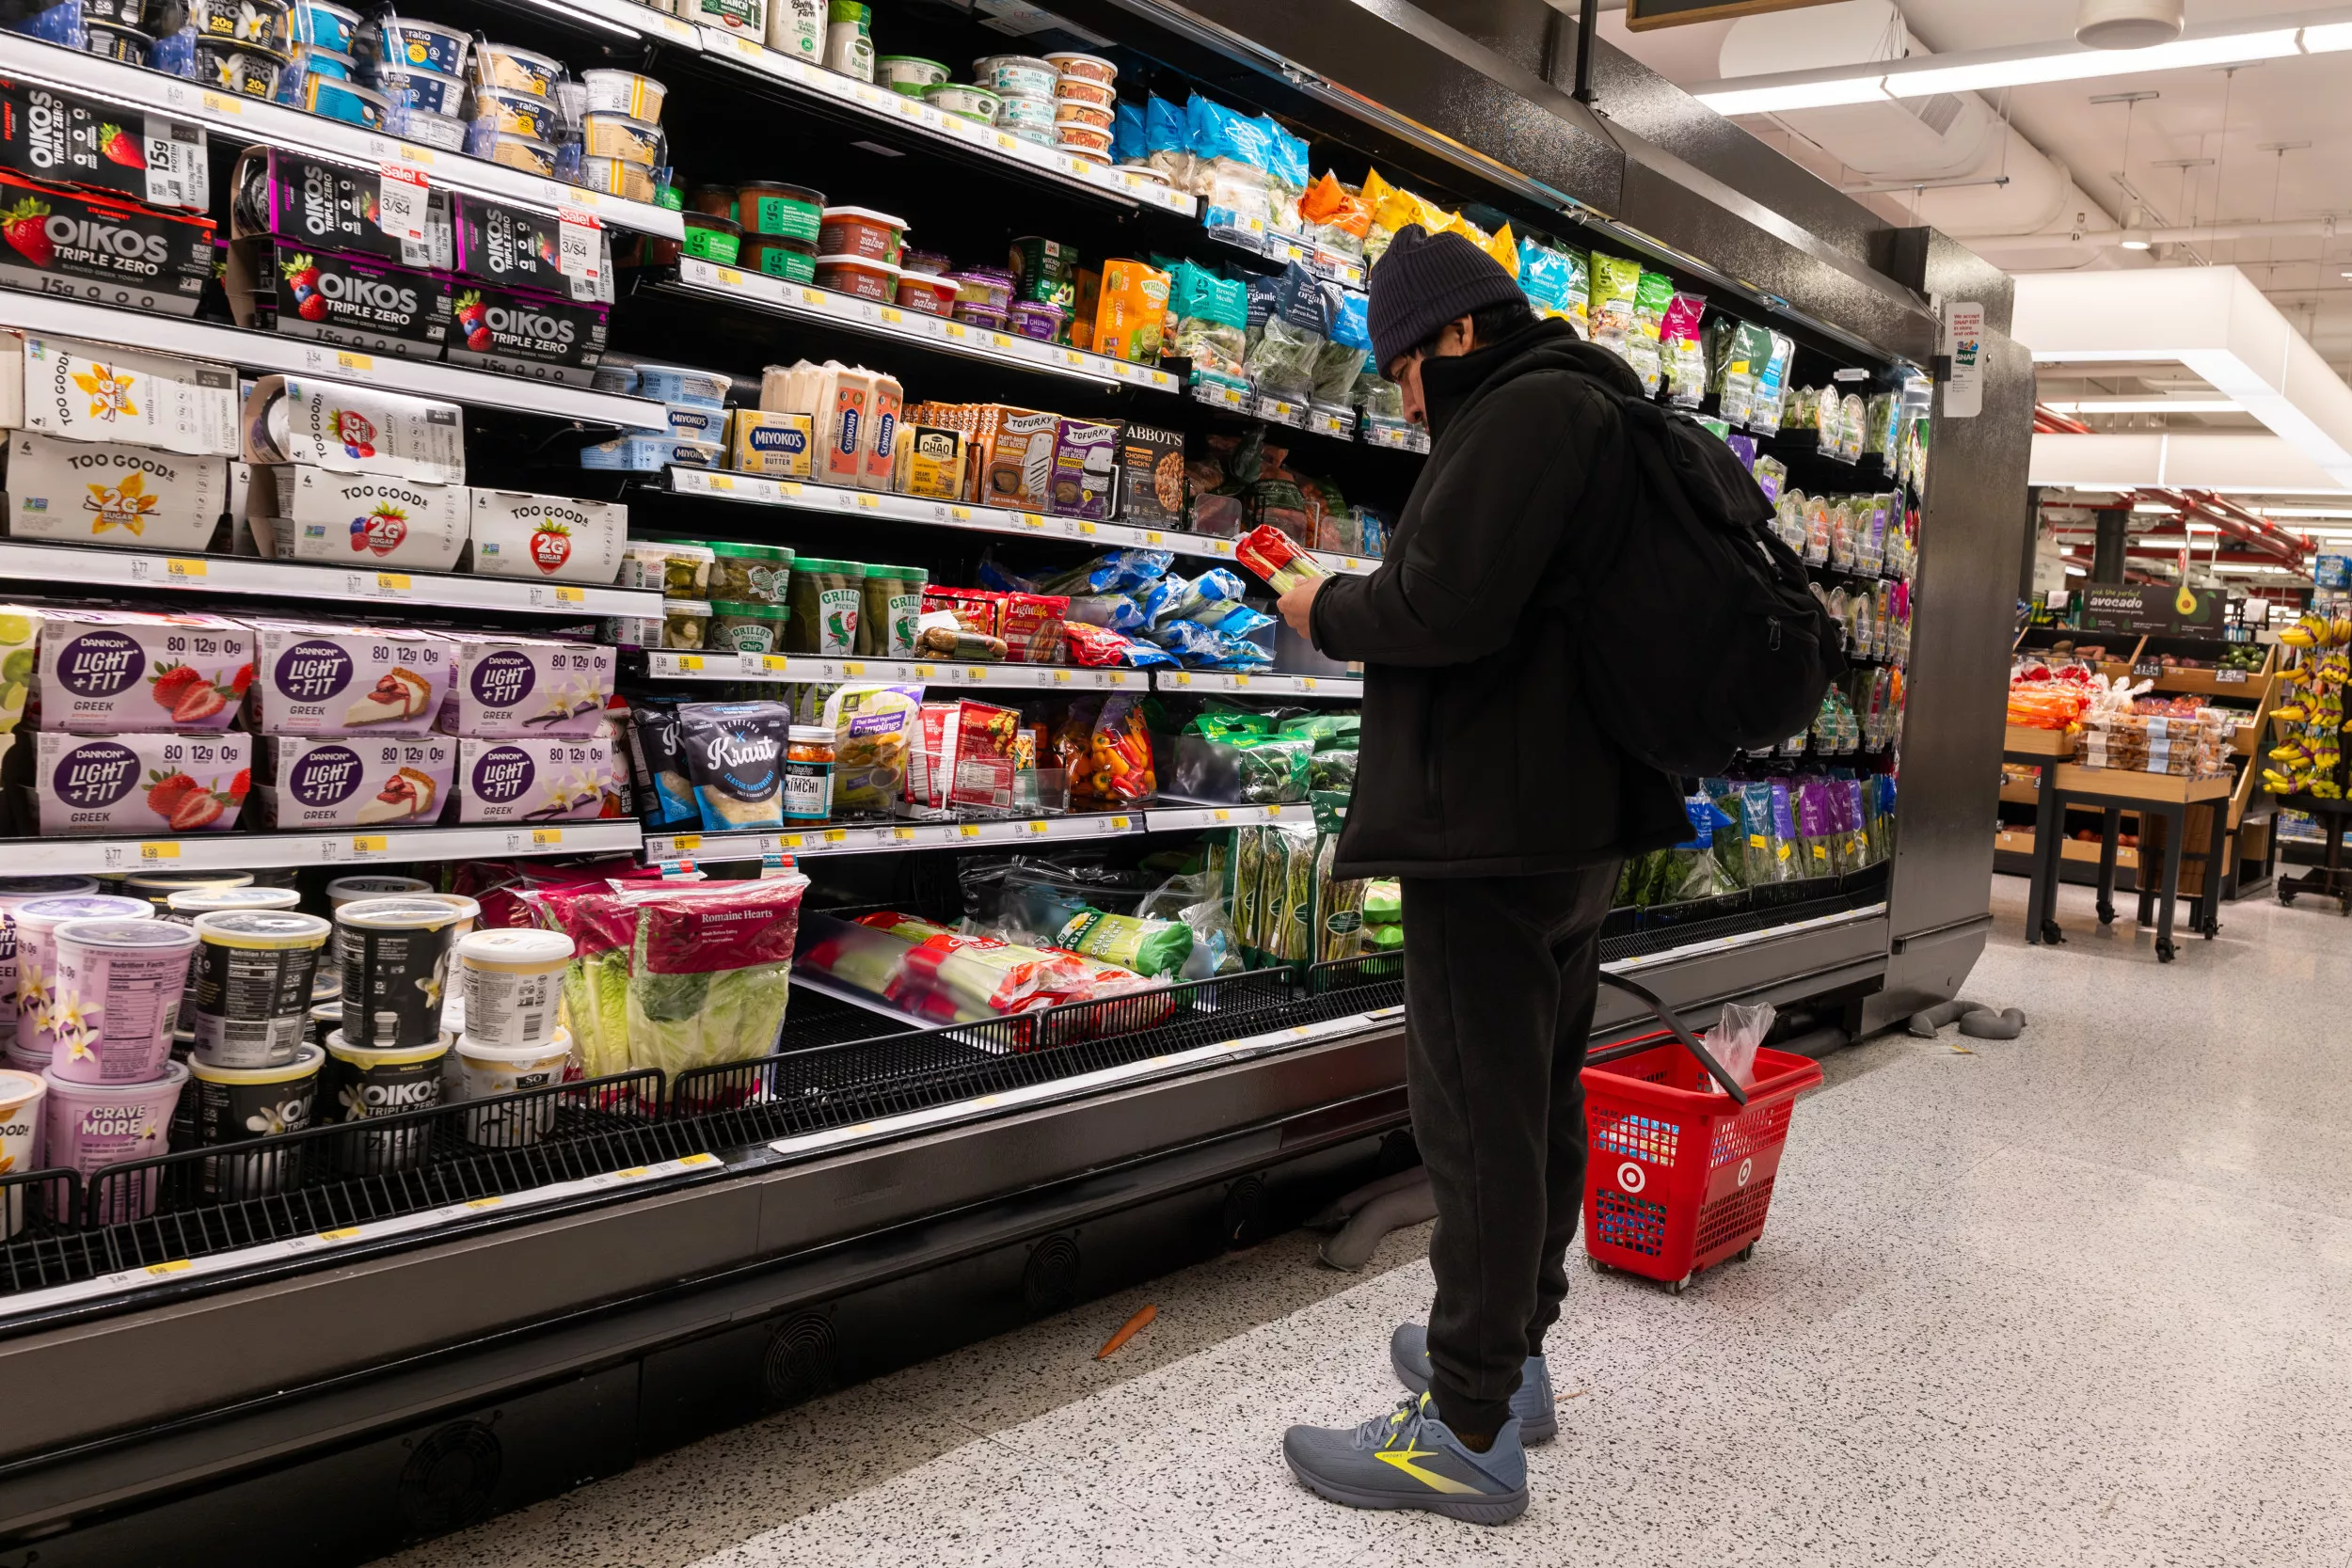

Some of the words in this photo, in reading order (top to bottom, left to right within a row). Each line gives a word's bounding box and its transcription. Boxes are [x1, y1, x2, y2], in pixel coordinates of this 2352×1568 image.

[207, 3, 239, 18] PRO
[210, 25, 232, 34] PROTEIN
[212, 16, 233, 29] 20g
[243, 64, 272, 82] PRO
[245, 87, 265, 97] PROTEIN
[246, 78, 266, 92] 20g
[54, 101, 64, 129] ZERO
[29, 90, 53, 167] OIKOS
[55, 130, 64, 165] TRIPLE
[151, 141, 169, 171] 15g
[381, 162, 417, 183] Sale!
[324, 174, 333, 199] ZERO
[304, 166, 326, 235] OIKOS
[87, 206, 131, 220] STRAWBERRY
[326, 201, 334, 232] TRIPLE
[560, 211, 590, 227] Sale!
[44, 215, 168, 263] OIKOS
[201, 230, 212, 240] 4
[486, 209, 505, 274] OIKOS
[860, 237, 884, 249] salsa
[53, 245, 109, 267] TRIPLE
[114, 257, 158, 276] ZERO
[505, 241, 514, 270] TRIPLE
[62, 263, 93, 274] BLENDED
[40, 277, 74, 296] 15g
[318, 273, 418, 313] OIKOS
[857, 285, 881, 296] salsa
[326, 299, 371, 318] TRIPLE
[374, 309, 410, 325] ZERO
[913, 299, 937, 310] salsa
[485, 308, 576, 343] OIKOS
[1029, 319, 1051, 328] CHUNKY
[492, 331, 532, 348] TRIPLE
[534, 340, 568, 354] ZERO
[94, 379, 116, 408] 2G
[56, 398, 72, 426] TOO
[386, 413, 395, 435] berry
[1011, 416, 1053, 428] TOFURKY
[342, 418, 359, 447] 2G
[998, 435, 1027, 443] PLANT-BASED
[1073, 428, 1108, 439] TOFURKY
[1126, 425, 1183, 446] ABBOT'S
[22, 441, 32, 451] 4
[315, 433, 327, 459] TOO
[923, 443, 950, 454] CHAO
[1058, 458, 1083, 467] PEPPERED
[1125, 452, 1152, 462] CHOPPED
[68, 453, 108, 470] TOO
[113, 454, 168, 479] GOOD
[304, 475, 311, 484] 4
[101, 488, 138, 513] 2G
[342, 485, 373, 500] TOO
[378, 486, 421, 507] GOOD
[479, 496, 485, 505] 4
[103, 511, 134, 521] SUGAR
[511, 506, 540, 519] TOO
[544, 506, 582, 524] GOOD
[368, 517, 399, 539] 2G
[369, 537, 395, 546] SUGAR
[537, 533, 564, 555] 2G
[538, 553, 562, 562] SUGAR
[168, 564, 184, 575] 4.99
[556, 593, 568, 601] 4.99
[2090, 597, 2143, 609] avocado
[1009, 604, 1048, 617] Lightlife
[167, 638, 185, 651] 80
[194, 639, 216, 654] 12g
[224, 640, 241, 655] 0g
[373, 646, 389, 659] 80
[398, 647, 417, 661] 12g
[424, 649, 438, 662] 0g
[740, 642, 763, 652] Chips
[72, 650, 134, 673] LIGHT
[288, 659, 342, 679] LIGHT
[552, 655, 565, 668] 80
[573, 656, 589, 669] 12g
[594, 657, 607, 669] 0g
[88, 672, 126, 690] FIT
[482, 668, 527, 688] LIGHT
[303, 678, 336, 696] FIT
[494, 685, 521, 702] FIT
[73, 702, 114, 711] GREEK
[290, 705, 326, 715] GREEK
[483, 711, 513, 720] GREEK
[879, 713, 902, 722] Vegetable
[854, 721, 900, 735] Dumplings
[165, 745, 183, 759] 80
[191, 746, 214, 760] 12g
[221, 746, 237, 761] 0g
[382, 748, 397, 760] 80
[405, 748, 423, 762] 12g
[429, 749, 444, 762] 0g
[549, 749, 564, 760] 80
[569, 749, 585, 761] 12g
[590, 749, 603, 761] 0g
[707, 736, 776, 769] Kraut
[69, 761, 130, 786] LIGHT
[302, 763, 354, 786] LIGHT
[483, 762, 527, 784] LIGHT
[86, 781, 121, 801] FIT
[316, 782, 347, 800] FIT
[495, 781, 522, 798] FIT
[786, 780, 818, 793] KIMCHI
[71, 812, 112, 822] GREEK
[304, 811, 337, 819] GREEK
[141, 848, 158, 858] 4.99
[702, 911, 742, 923] Romaine
[744, 910, 772, 920] Hearts
[363, 1076, 440, 1105] OIKOS
[92, 1104, 147, 1118] CRAVE
[82, 1118, 140, 1135] MORE
